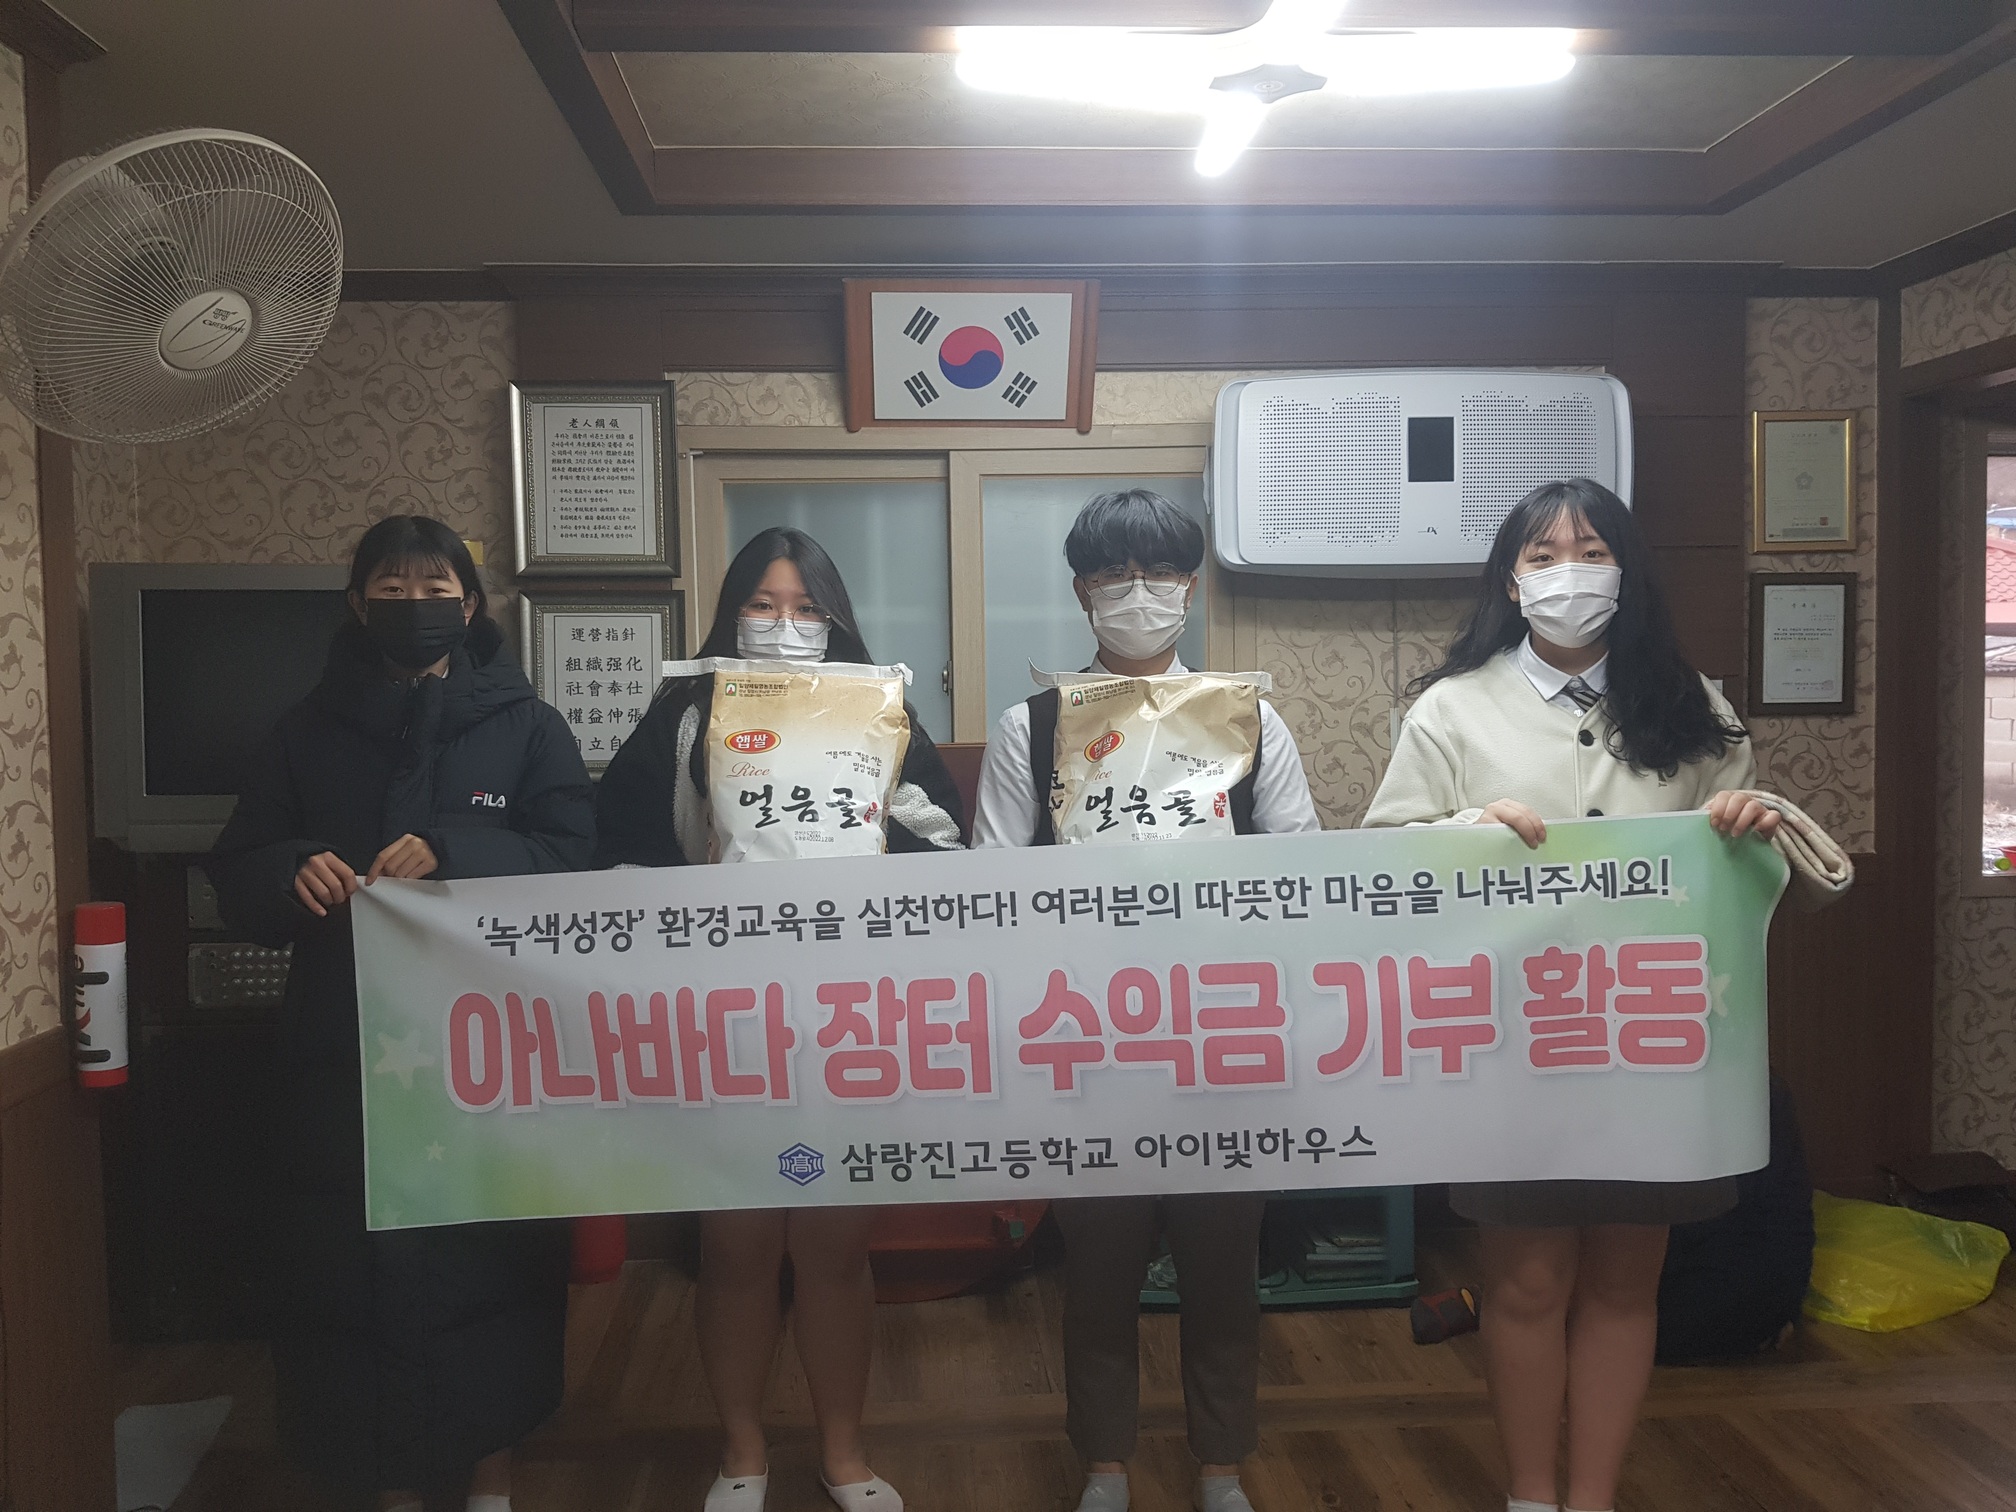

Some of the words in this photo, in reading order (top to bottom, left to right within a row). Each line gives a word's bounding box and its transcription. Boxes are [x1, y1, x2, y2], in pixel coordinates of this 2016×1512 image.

[571, 628, 636, 642] 運營指針
[565, 680, 643, 696] 社會奉仕
[736, 734, 768, 749] 햅쌀
[726, 761, 770, 778] Rice
[472, 791, 506, 808] FILA
[740, 784, 862, 829] 얼음골
[1085, 785, 1207, 832] 얼음골
[657, 900, 845, 948] 환경교육을
[858, 890, 1018, 938] 실천하다!
[1031, 882, 1182, 927] 여러분의
[1195, 877, 1313, 922] 따뜻한
[1324, 871, 1444, 916] 마음을
[1457, 858, 1669, 906] 나눠주세요!
[448, 982, 796, 1106] 아나바다
[816, 972, 1000, 1098] 장터
[1018, 962, 1287, 1091] 수익금
[1311, 953, 1496, 1077] 기부
[1523, 941, 1707, 1068] 활동
[840, 1137, 1118, 1183] 삼랑진고등학교
[1135, 1125, 1377, 1170] 아이빛하우스
